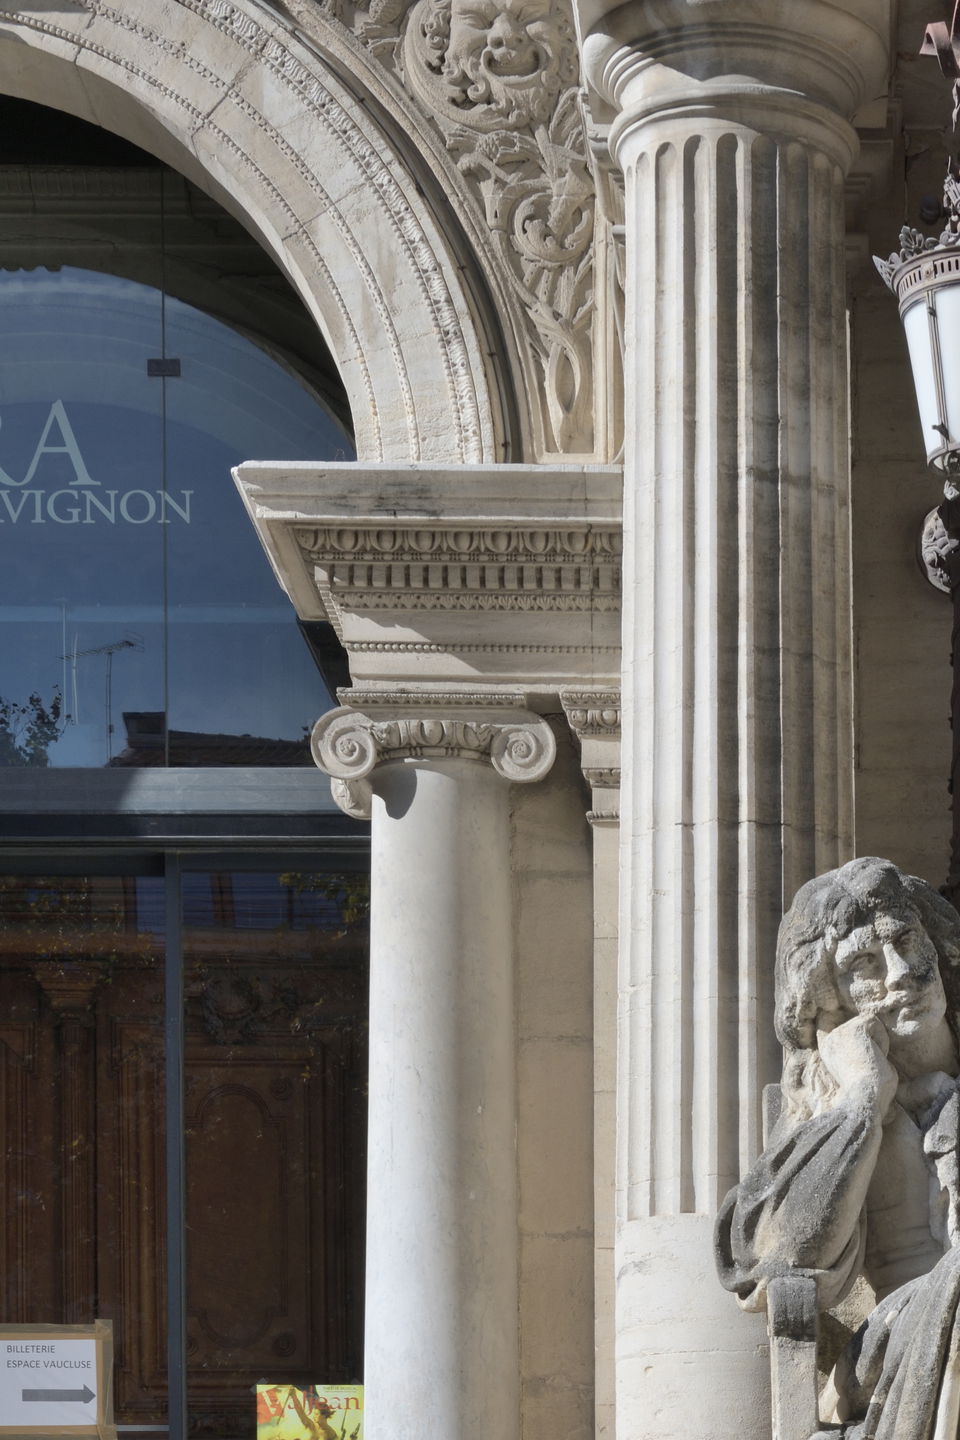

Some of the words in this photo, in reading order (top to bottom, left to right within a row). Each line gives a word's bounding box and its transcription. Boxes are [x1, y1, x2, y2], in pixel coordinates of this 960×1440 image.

[0, 399, 101, 486] A
[0, 489, 194, 524] VIGNON
[6, 1344, 56, 1354] BILLETERIE
[6, 1360, 41, 1369] ESPACE
[43, 1360, 92, 1369] VAUCLUSE
